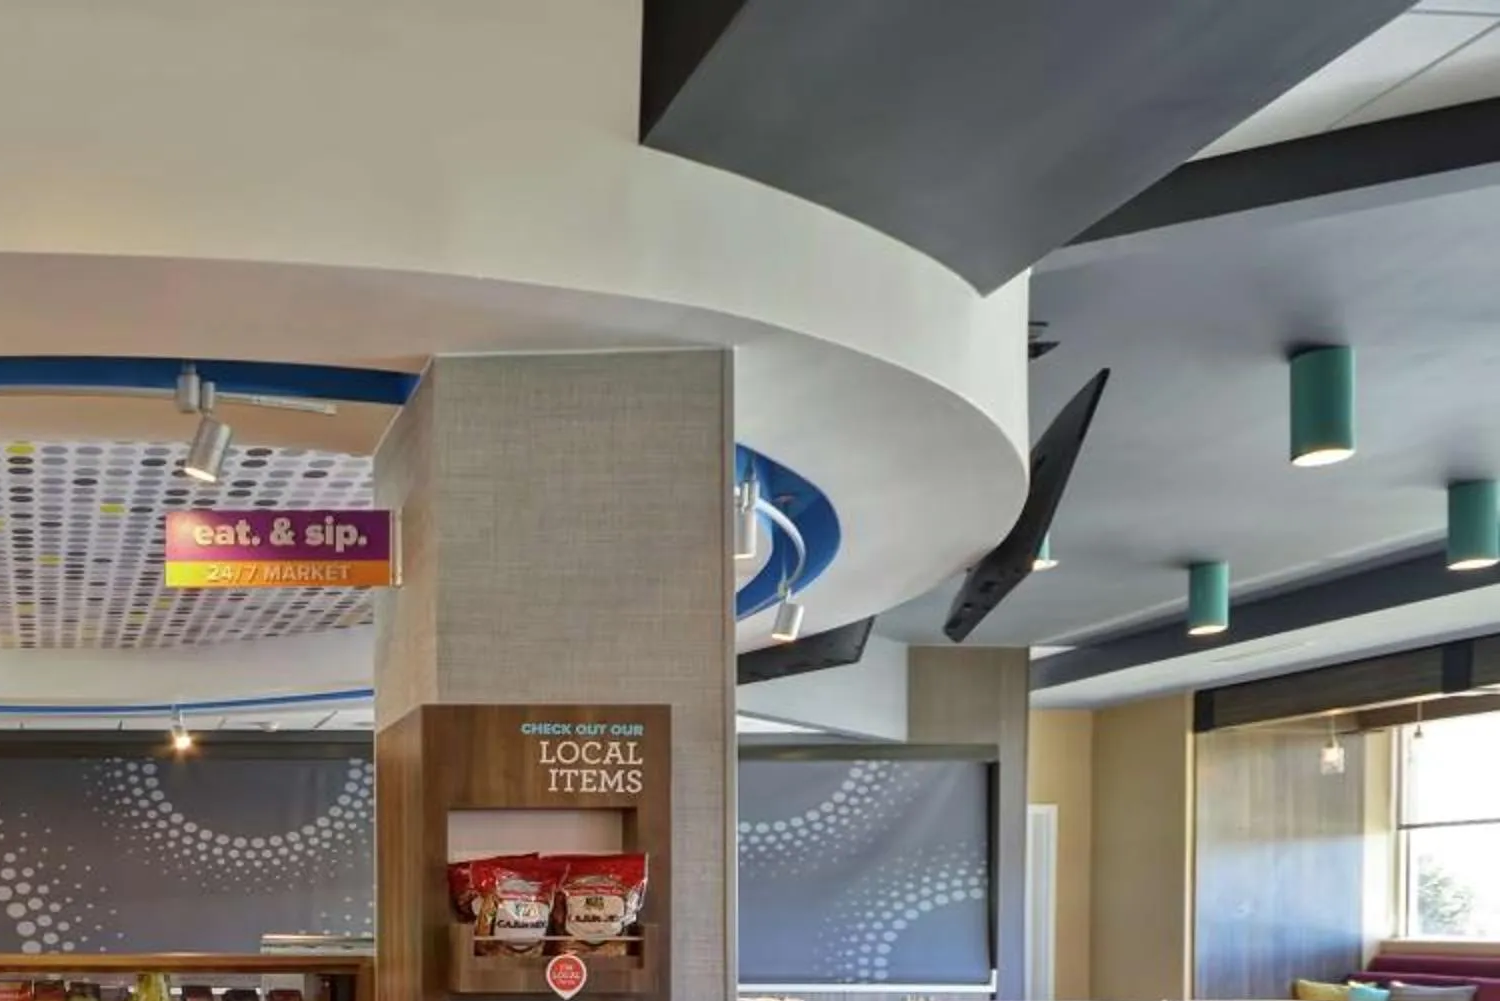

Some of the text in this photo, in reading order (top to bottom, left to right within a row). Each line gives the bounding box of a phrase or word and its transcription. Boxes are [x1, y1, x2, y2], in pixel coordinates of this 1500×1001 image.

[194, 516, 367, 552] eat. & sip.
[206, 564, 351, 582] 24/7 MARKET
[521, 723, 644, 736] CHECK OUT OUR
[540, 741, 643, 765] LOCAL
[548, 769, 643, 793] ITEMS
